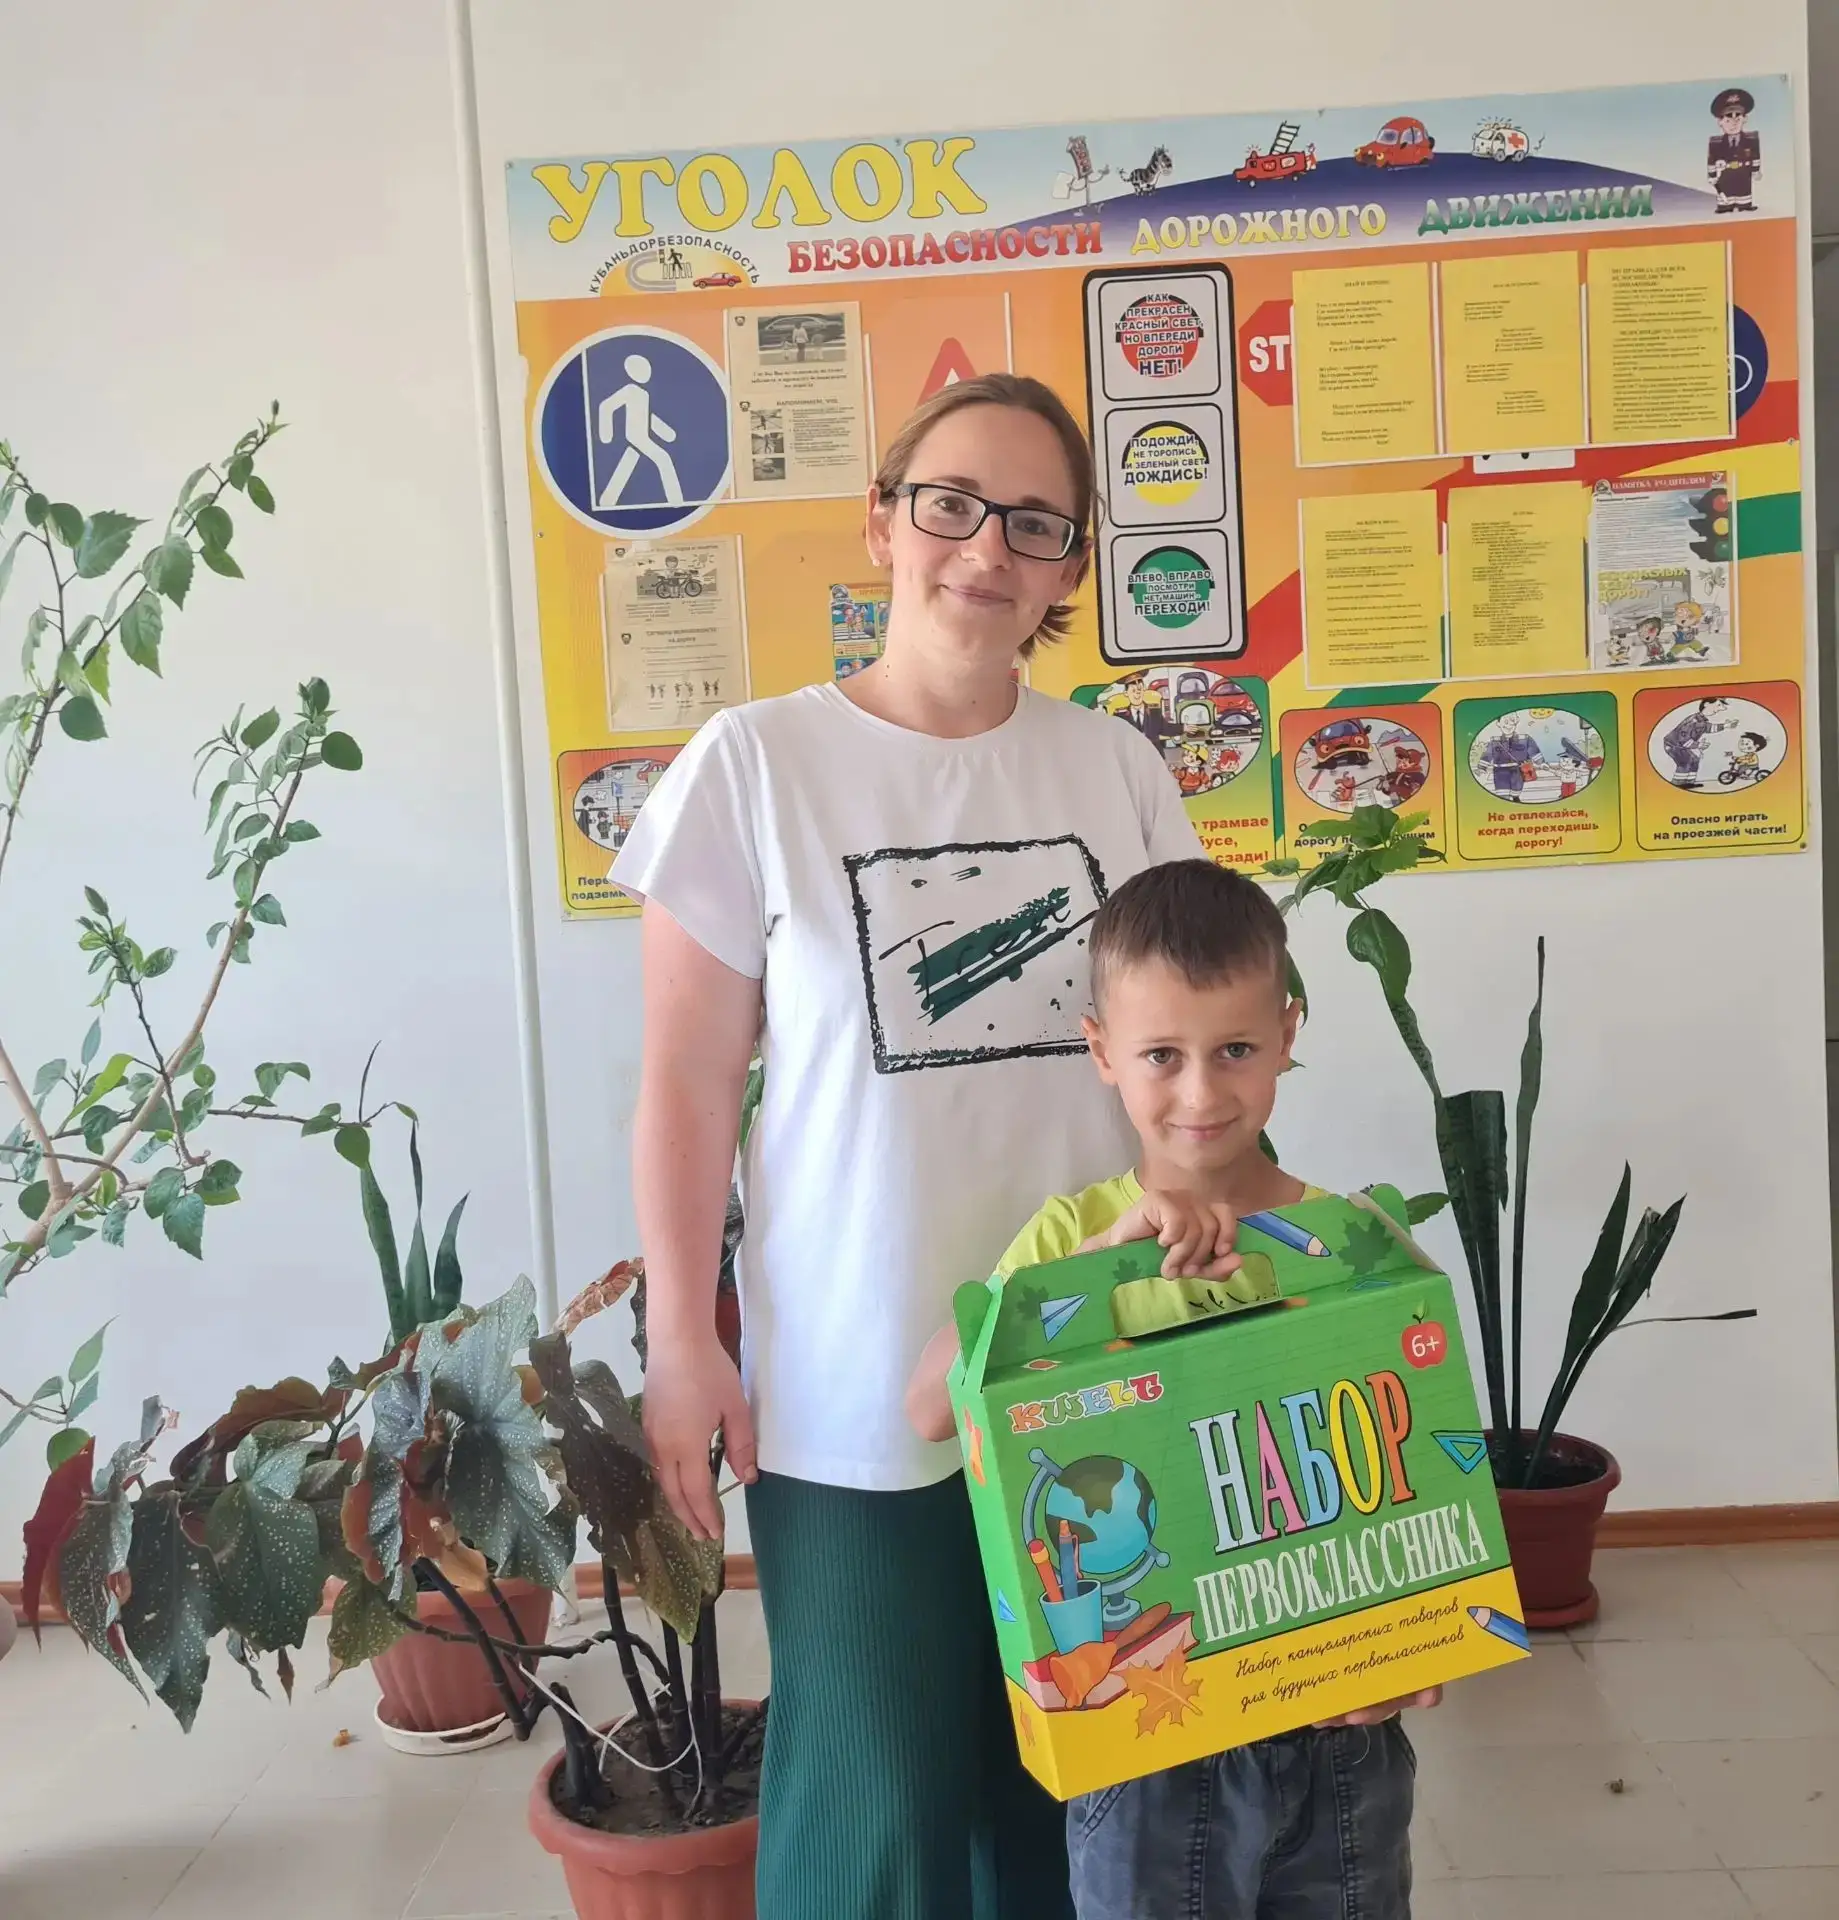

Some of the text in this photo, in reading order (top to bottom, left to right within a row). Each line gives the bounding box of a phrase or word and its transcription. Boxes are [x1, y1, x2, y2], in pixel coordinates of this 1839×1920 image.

[532, 137, 987, 243] УГОЛОК
[787, 184, 1654, 273] БЕЗОПАСНОСТИ ДОРОЖНОГО ДВИЖЕНИЯ
[590, 235, 761, 294] КУБАНЬДОРБЕЗОПАСНОСТЬ
[1147, 293, 1169, 302] КАК
[1126, 304, 1190, 317] ПРЕКРАСЕН
[1115, 317, 1204, 331] КРАСНЫЙ СВЕТ,
[1124, 331, 1195, 344] НО ВПЕРЕДИ
[1138, 345, 1183, 357] ДОРОГИ
[1249, 335, 1291, 374] ST
[1139, 359, 1183, 376] НЕТ!
[1131, 434, 1199, 449] ПОДОЖДИ,
[1133, 448, 1197, 459] НЕ ТОРОПИСЬ
[1135, 458, 1179, 469] ЗЕЛЕНЫЙ
[1124, 467, 1208, 486] ДОЖДИСЬ!
[1128, 573, 1166, 583] ВЛЕВО,
[1148, 583, 1195, 592] ПОСМОТРИ
[1134, 601, 1211, 616] ПЕРЕХОДИ!
[1487, 808, 1589, 822] Не отвлекайся,
[1670, 812, 1769, 826] Опасно играть
[1201, 817, 1269, 832] трамвае
[1478, 823, 1599, 837] когда переходишь
[1653, 823, 1787, 841] на проезжей части!
[1198, 835, 1238, 850] бусе,
[1294, 836, 1338, 848] дорогу
[1515, 836, 1563, 850] дорогу!
[578, 876, 609, 888] Пере
[571, 890, 627, 901] подземн
[1411, 1334, 1441, 1358] 6+
[1189, 1370, 1417, 1555] НАБОР
[1194, 1498, 1490, 1643] ПЕРВОКЛАССНИКА
[1235, 1596, 1459, 1679] Набор канцелярских товаров
[1240, 1623, 1465, 1714] для будущих первоклассников
